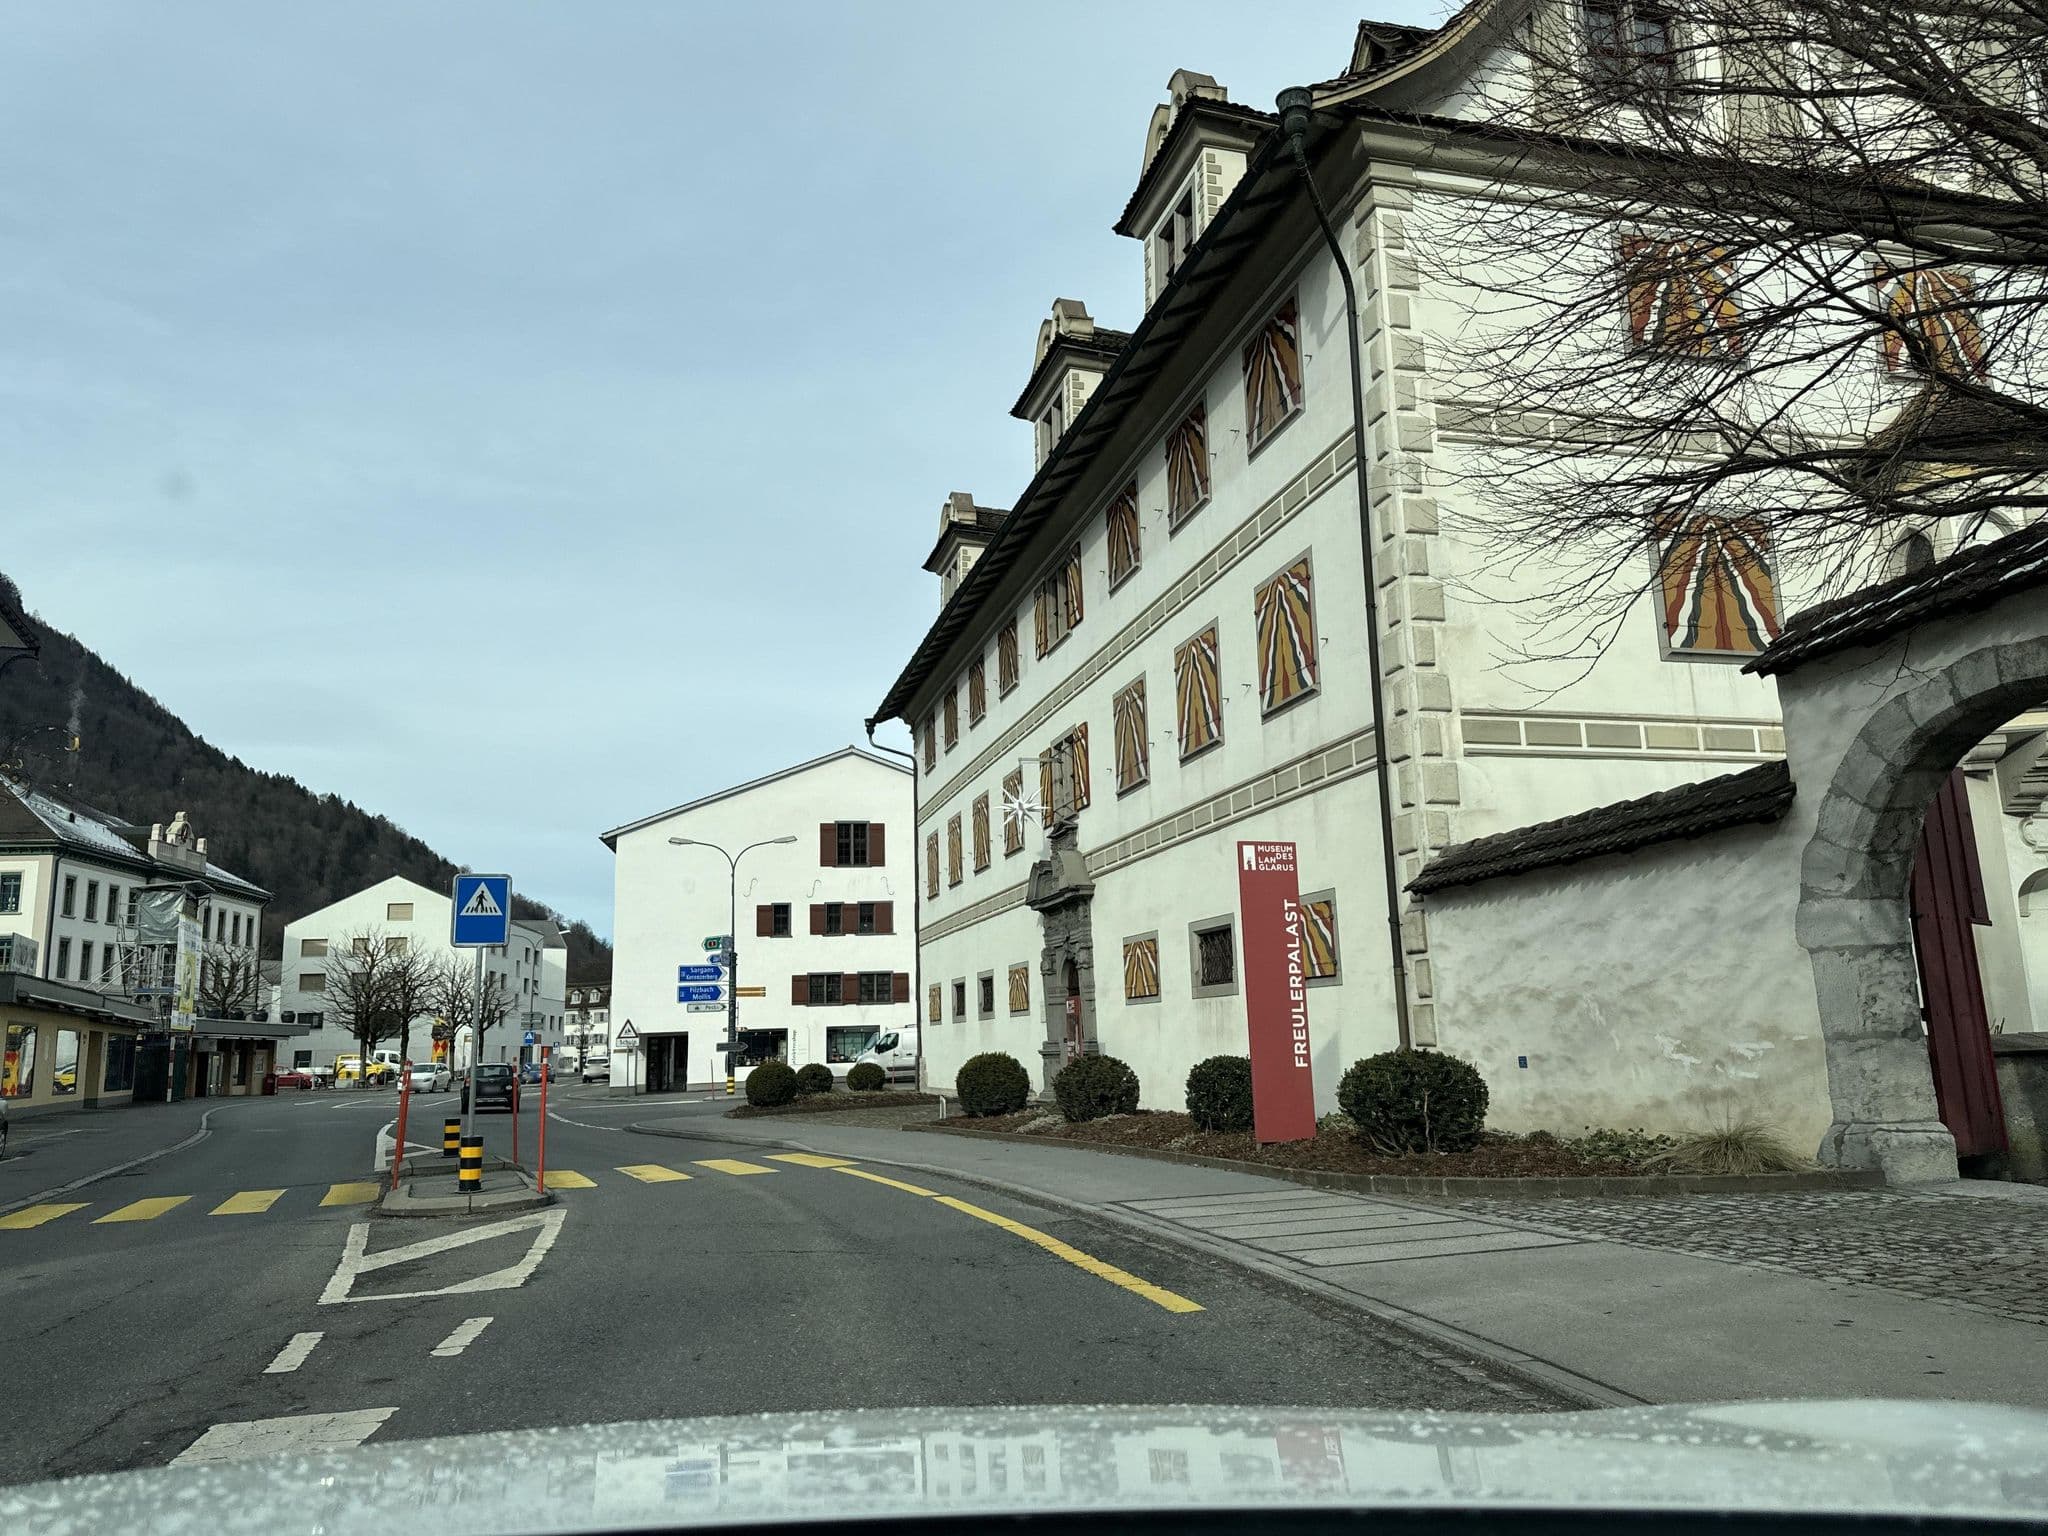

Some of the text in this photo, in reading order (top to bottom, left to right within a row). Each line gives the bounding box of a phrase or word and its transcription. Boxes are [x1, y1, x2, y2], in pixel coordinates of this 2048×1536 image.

[1257, 844, 1293, 852] MUSEUM
[1275, 852, 1293, 860] DES
[1258, 863, 1295, 871] GLARUS
[1284, 899, 1308, 1068] FREULERPALAST
